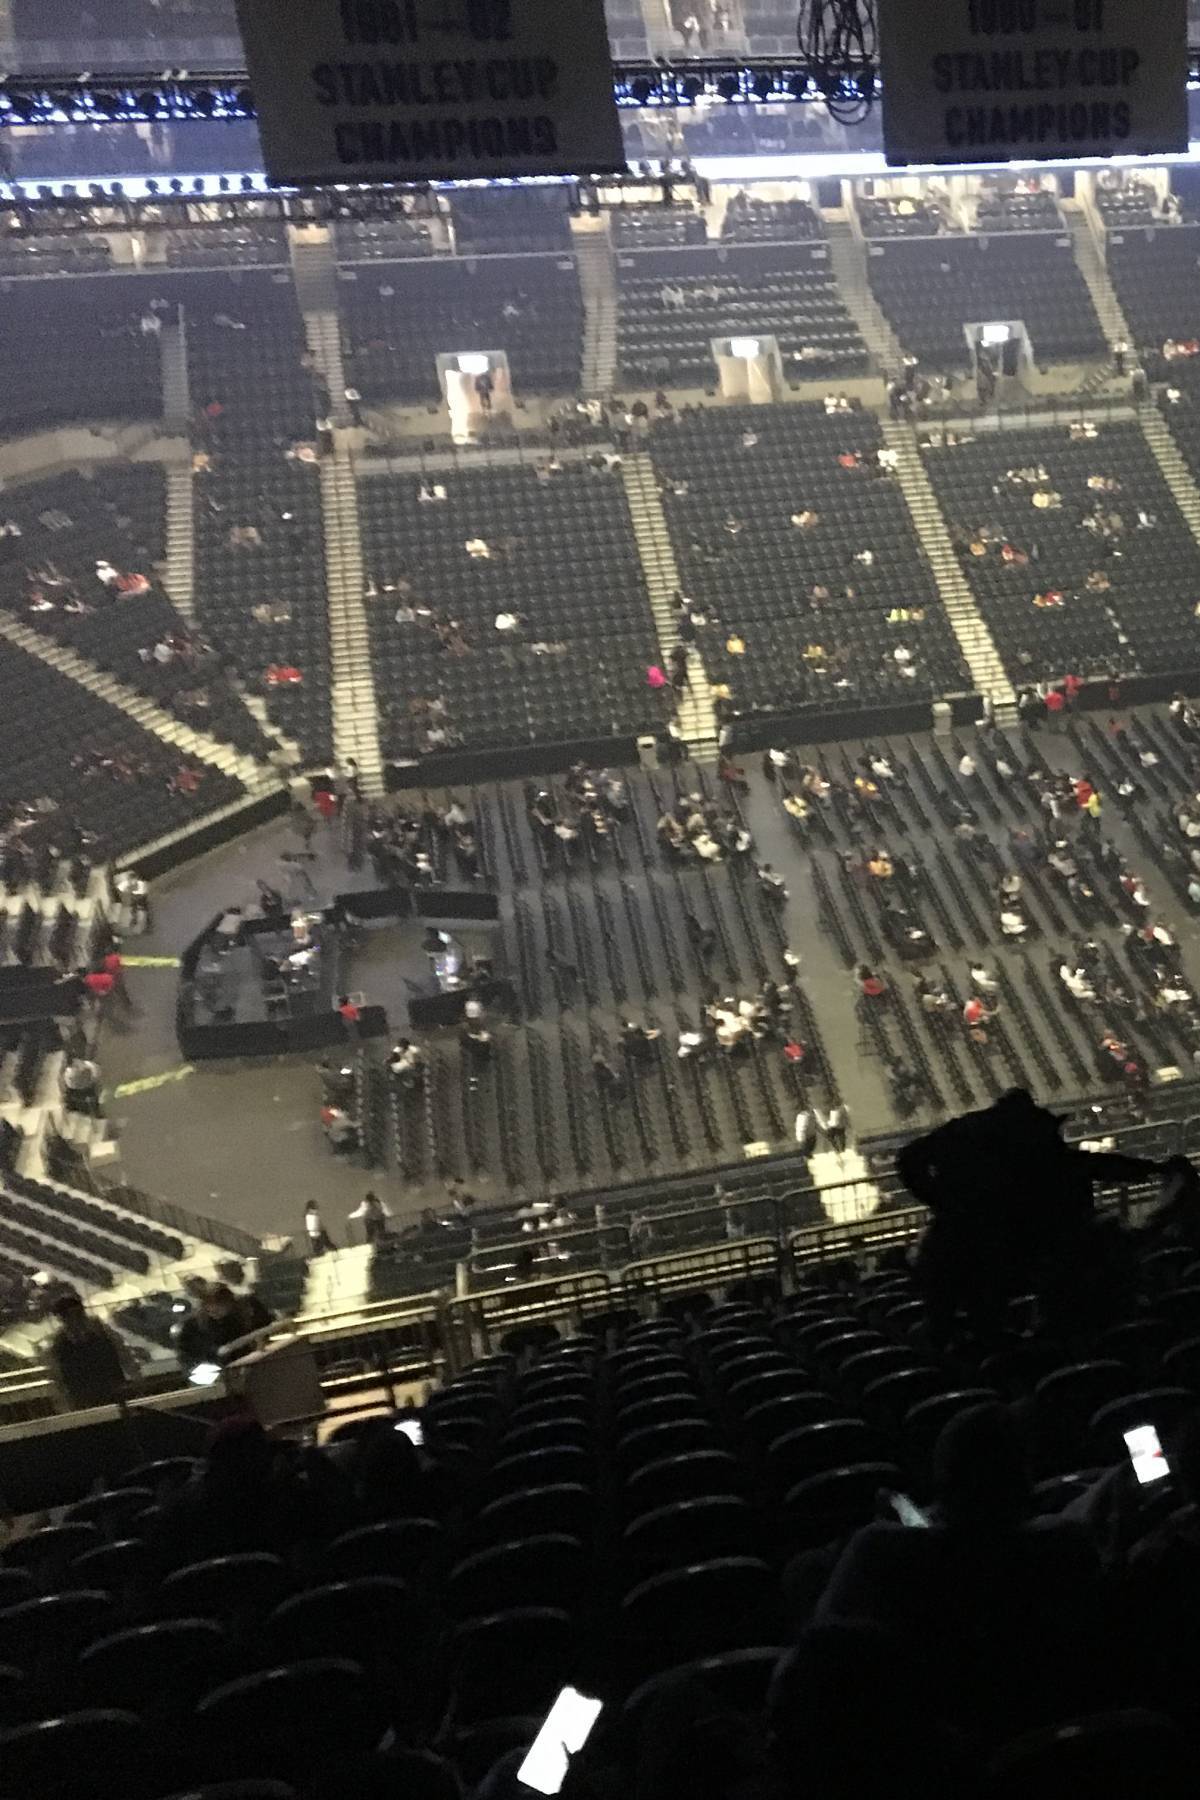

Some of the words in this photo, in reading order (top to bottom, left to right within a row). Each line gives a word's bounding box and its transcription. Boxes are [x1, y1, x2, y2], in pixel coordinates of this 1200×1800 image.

[311, 58, 478, 106] STANLEY
[485, 55, 559, 101] CUP
[932, 48, 1072, 92] STANLEY
[1078, 46, 1140, 87] CUP
[333, 115, 558, 163] CHAMPIONS
[945, 100, 1132, 147] CHAMPIONS
